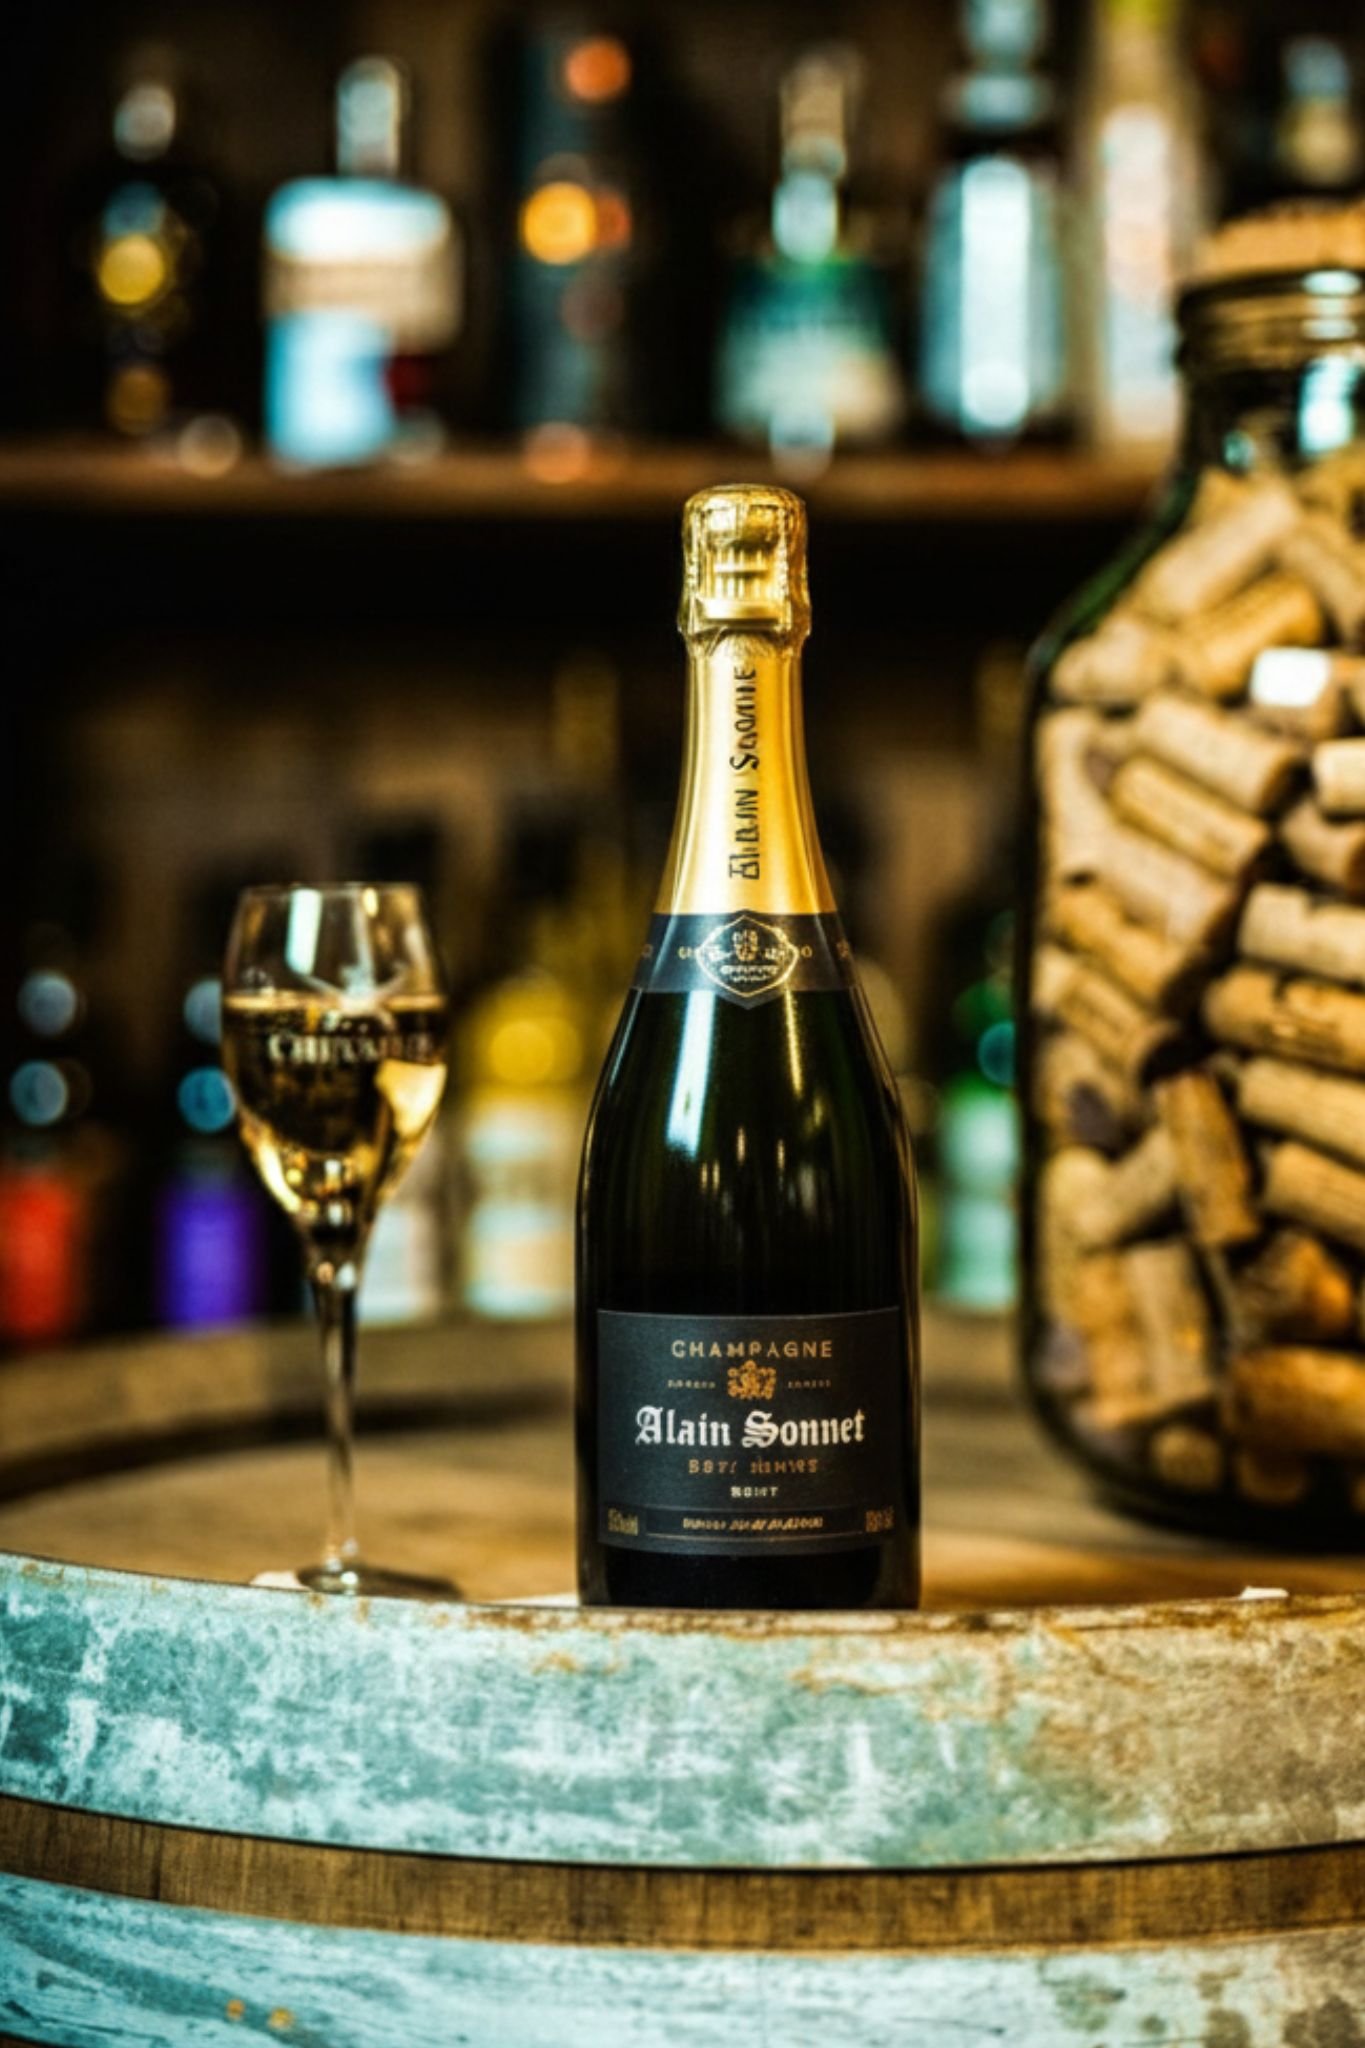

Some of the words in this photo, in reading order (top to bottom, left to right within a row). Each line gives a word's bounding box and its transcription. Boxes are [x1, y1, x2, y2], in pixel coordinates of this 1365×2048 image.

[671, 1340, 833, 1358] CHAMPAGNE
[635, 1405, 731, 1446] Alain
[741, 1408, 865, 1448] Sonnet
